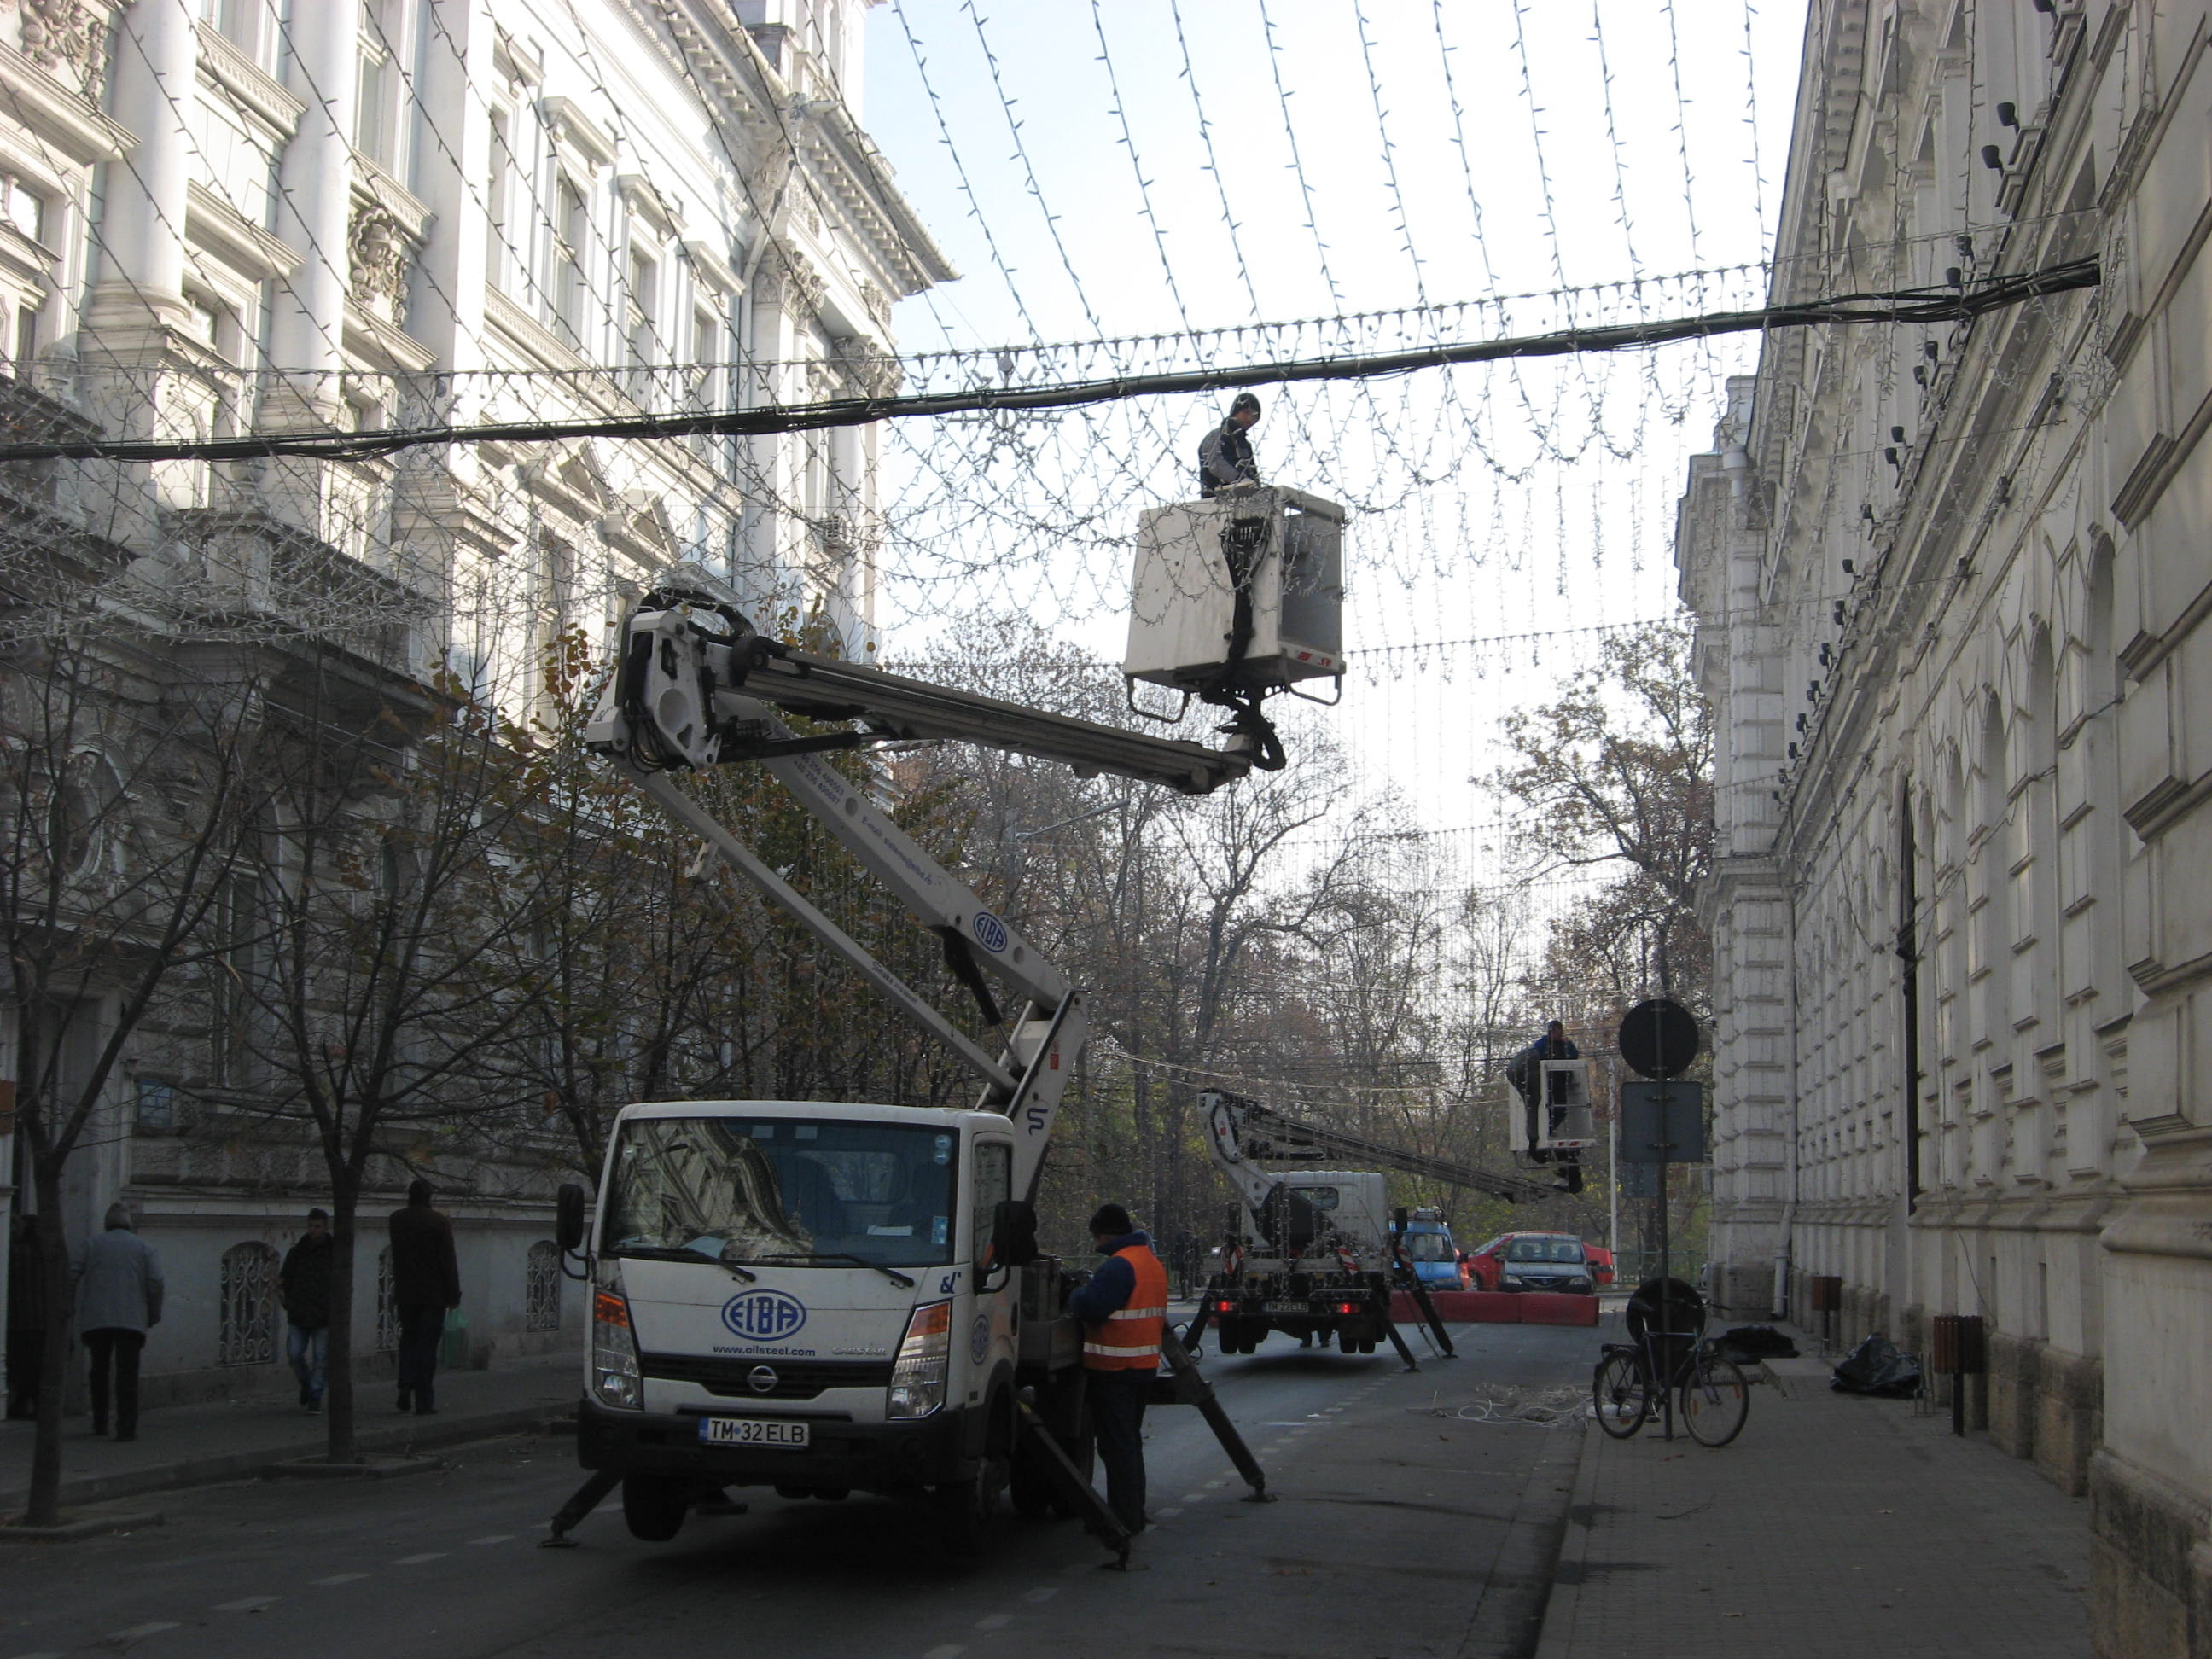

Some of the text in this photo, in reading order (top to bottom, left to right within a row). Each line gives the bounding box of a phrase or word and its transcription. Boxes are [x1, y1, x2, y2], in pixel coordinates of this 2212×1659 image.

[976, 917, 1005, 947] ELBA
[729, 1295, 799, 1334] ELBA
[713, 1345, 816, 1357] www.oilsteel.com
[712, 1420, 734, 1438] TM
[741, 1423, 763, 1441] 32
[767, 1426, 805, 1444] ELB
